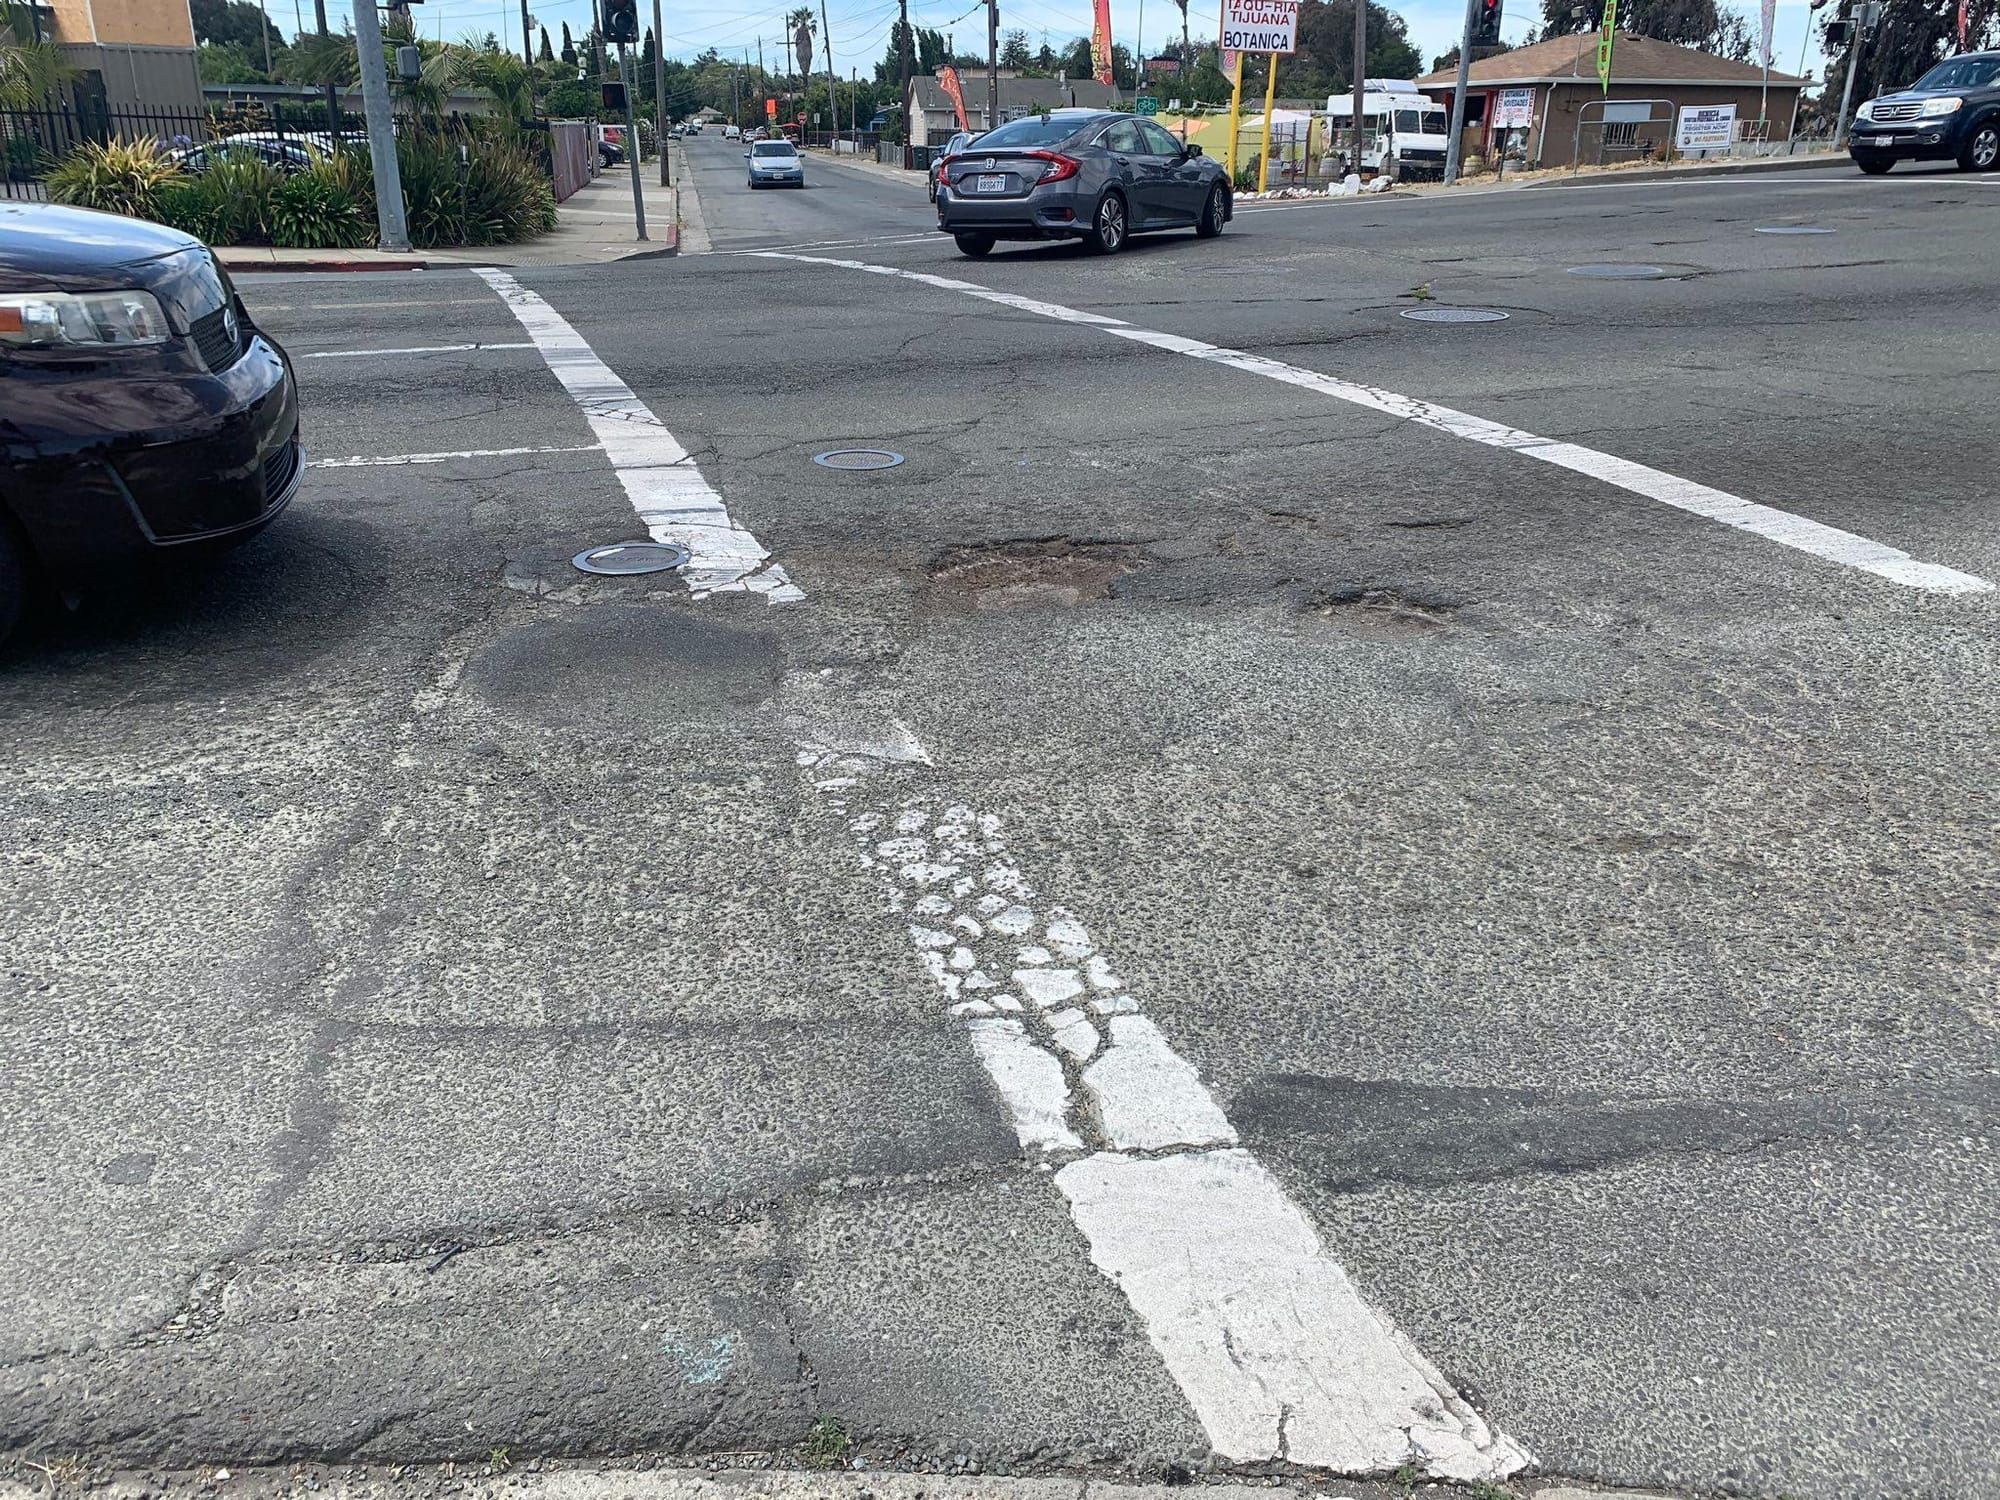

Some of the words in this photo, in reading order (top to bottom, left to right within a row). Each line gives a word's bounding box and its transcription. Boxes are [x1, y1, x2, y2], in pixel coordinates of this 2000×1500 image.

[1230, 11, 1290, 26] TIJUANA
[1224, 31, 1289, 50] BOTANICA
[1503, 99, 1529, 107] NOVEDADES
